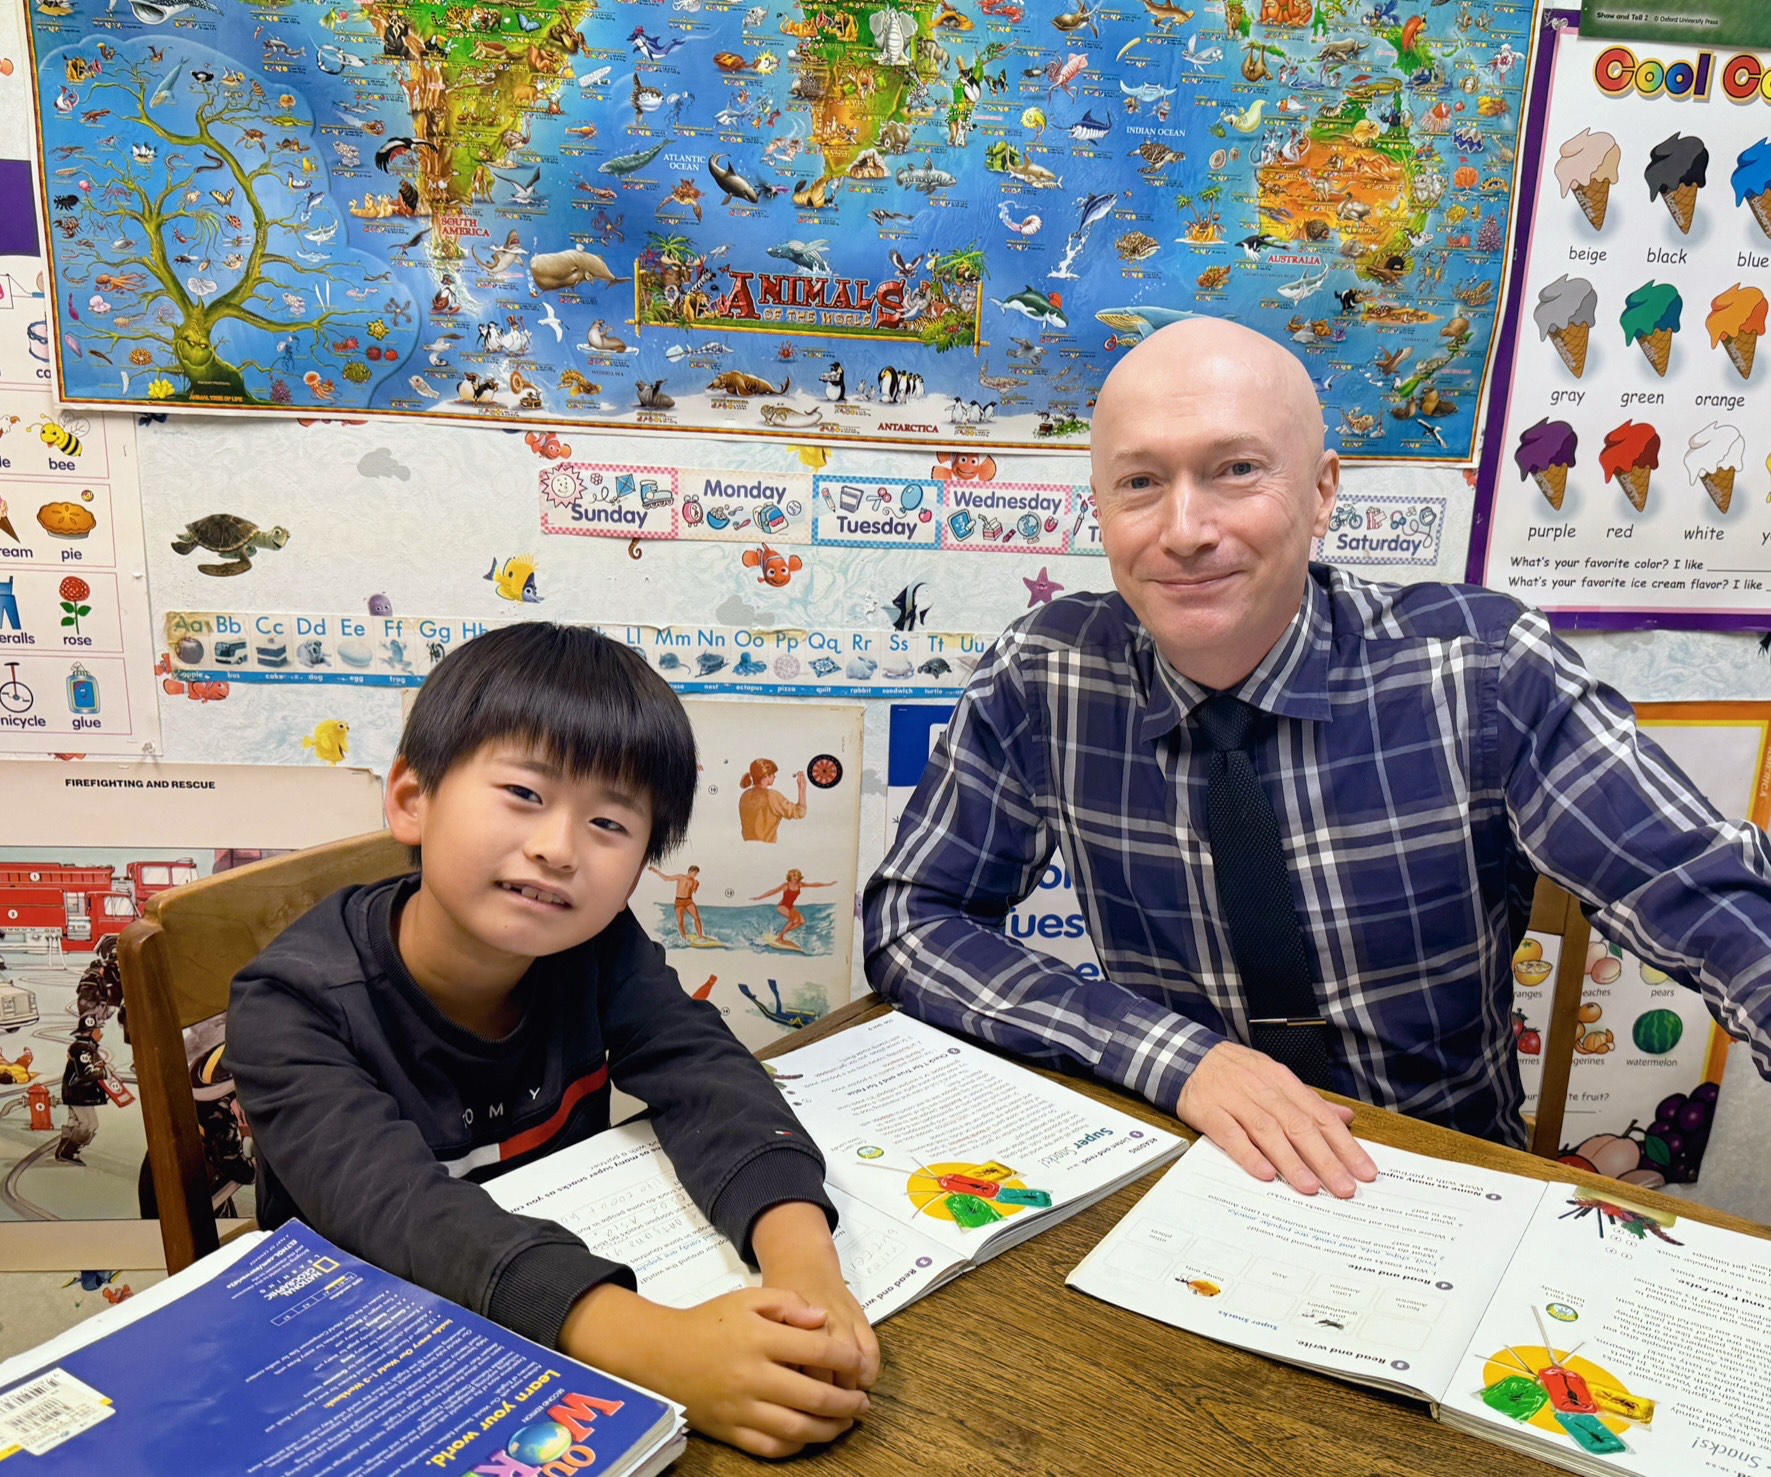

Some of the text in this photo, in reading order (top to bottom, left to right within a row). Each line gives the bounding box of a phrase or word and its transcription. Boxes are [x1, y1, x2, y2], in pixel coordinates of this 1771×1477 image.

[1631, 13, 1643, 21] Tell
[1679, 16, 1704, 25] University
[1594, 46, 1712, 98] Cool
[1126, 126, 1187, 138] INDIAN OCEAN
[663, 153, 706, 164] ATLANTIC
[669, 161, 700, 172] OCEAN
[1575, 190, 1595, 220] coffee
[441, 217, 478, 227] SOUTH
[442, 227, 490, 237] AMERICA
[1267, 255, 1321, 265] AUSTRALIA
[1569, 246, 1769, 268] beige black blue
[720, 270, 907, 330] ANIMALS
[763, 310, 873, 327] OF THE WORLD
[1550, 390, 1745, 411] gray green orange
[878, 422, 940, 433] ANTARCTICA
[48, 457, 76, 471] bee
[703, 479, 787, 504] Monday
[953, 490, 1062, 515] Wednesday
[570, 504, 648, 528] Sunday
[837, 515, 917, 540] Tuesday
[1528, 523, 1577, 541] purple
[1606, 524, 1634, 538] red
[1684, 525, 1725, 540] white
[1336, 533, 1422, 556] Saturday
[61, 547, 83, 562] pie
[1510, 556, 1704, 570] What's your favorite color? I like
[1508, 576, 1763, 590] What's your favorite ice cream flavor? I like
[174, 616, 203, 633] Aa
[216, 616, 242, 634] Bb
[256, 617, 284, 635] Cc
[297, 618, 326, 636] Dd
[341, 619, 365, 637] Ee
[384, 620, 403, 638] Ff
[419, 620, 450, 644] Gg
[63, 635, 92, 646] rose
[655, 629, 691, 646] Mm
[697, 629, 726, 647] Nn
[735, 630, 765, 648] Oo
[776, 632, 799, 653] Pp
[808, 632, 842, 654] Qq
[852, 633, 872, 651] Rr
[889, 634, 909, 651] Ss
[927, 635, 944, 652] Tt
[961, 635, 985, 653] Uu
[227, 671, 240, 679] bus
[308, 673, 323, 682] dog
[389, 675, 406, 684] frog
[735, 684, 763, 692] octopus
[777, 685, 796, 693] pizza
[816, 686, 832, 694] quilt
[882, 687, 913, 695] sandwich
[0, 715, 102, 730] nicycle glue
[65, 778, 216, 789] FIREFIGHTING AND RESCUE
[1513, 988, 1675, 1000] ranges eaches pears
[1572, 1057, 1678, 1068] gerines watermelon
[1581, 1092, 1610, 1102] fruit?
[1073, 1127, 1114, 1150] Super
[1098, 1147, 1112, 1157] and
[557, 1153, 640, 1192] many super snacks
[1346, 1262, 1431, 1285] Read and write.
[263, 1267, 316, 1301] GEOGRAPHIC
[283, 1271, 323, 1297] NATIONAL
[877, 1267, 917, 1301] Read and
[432, 1318, 454, 1335] Inside
[1218, 1310, 1279, 1331] Super Snacks
[412, 1333, 433, 1349] every
[399, 1348, 414, 1360] Our
[1296, 1339, 1386, 1364] Read and write.
[377, 1358, 400, 1375] World
[514, 1369, 561, 1403] Learn
[521, 1388, 565, 1424] SECOND EDITION
[480, 1400, 517, 1431] your
[425, 1430, 480, 1469] world.
[1691, 1436, 1762, 1471] Snacks!
